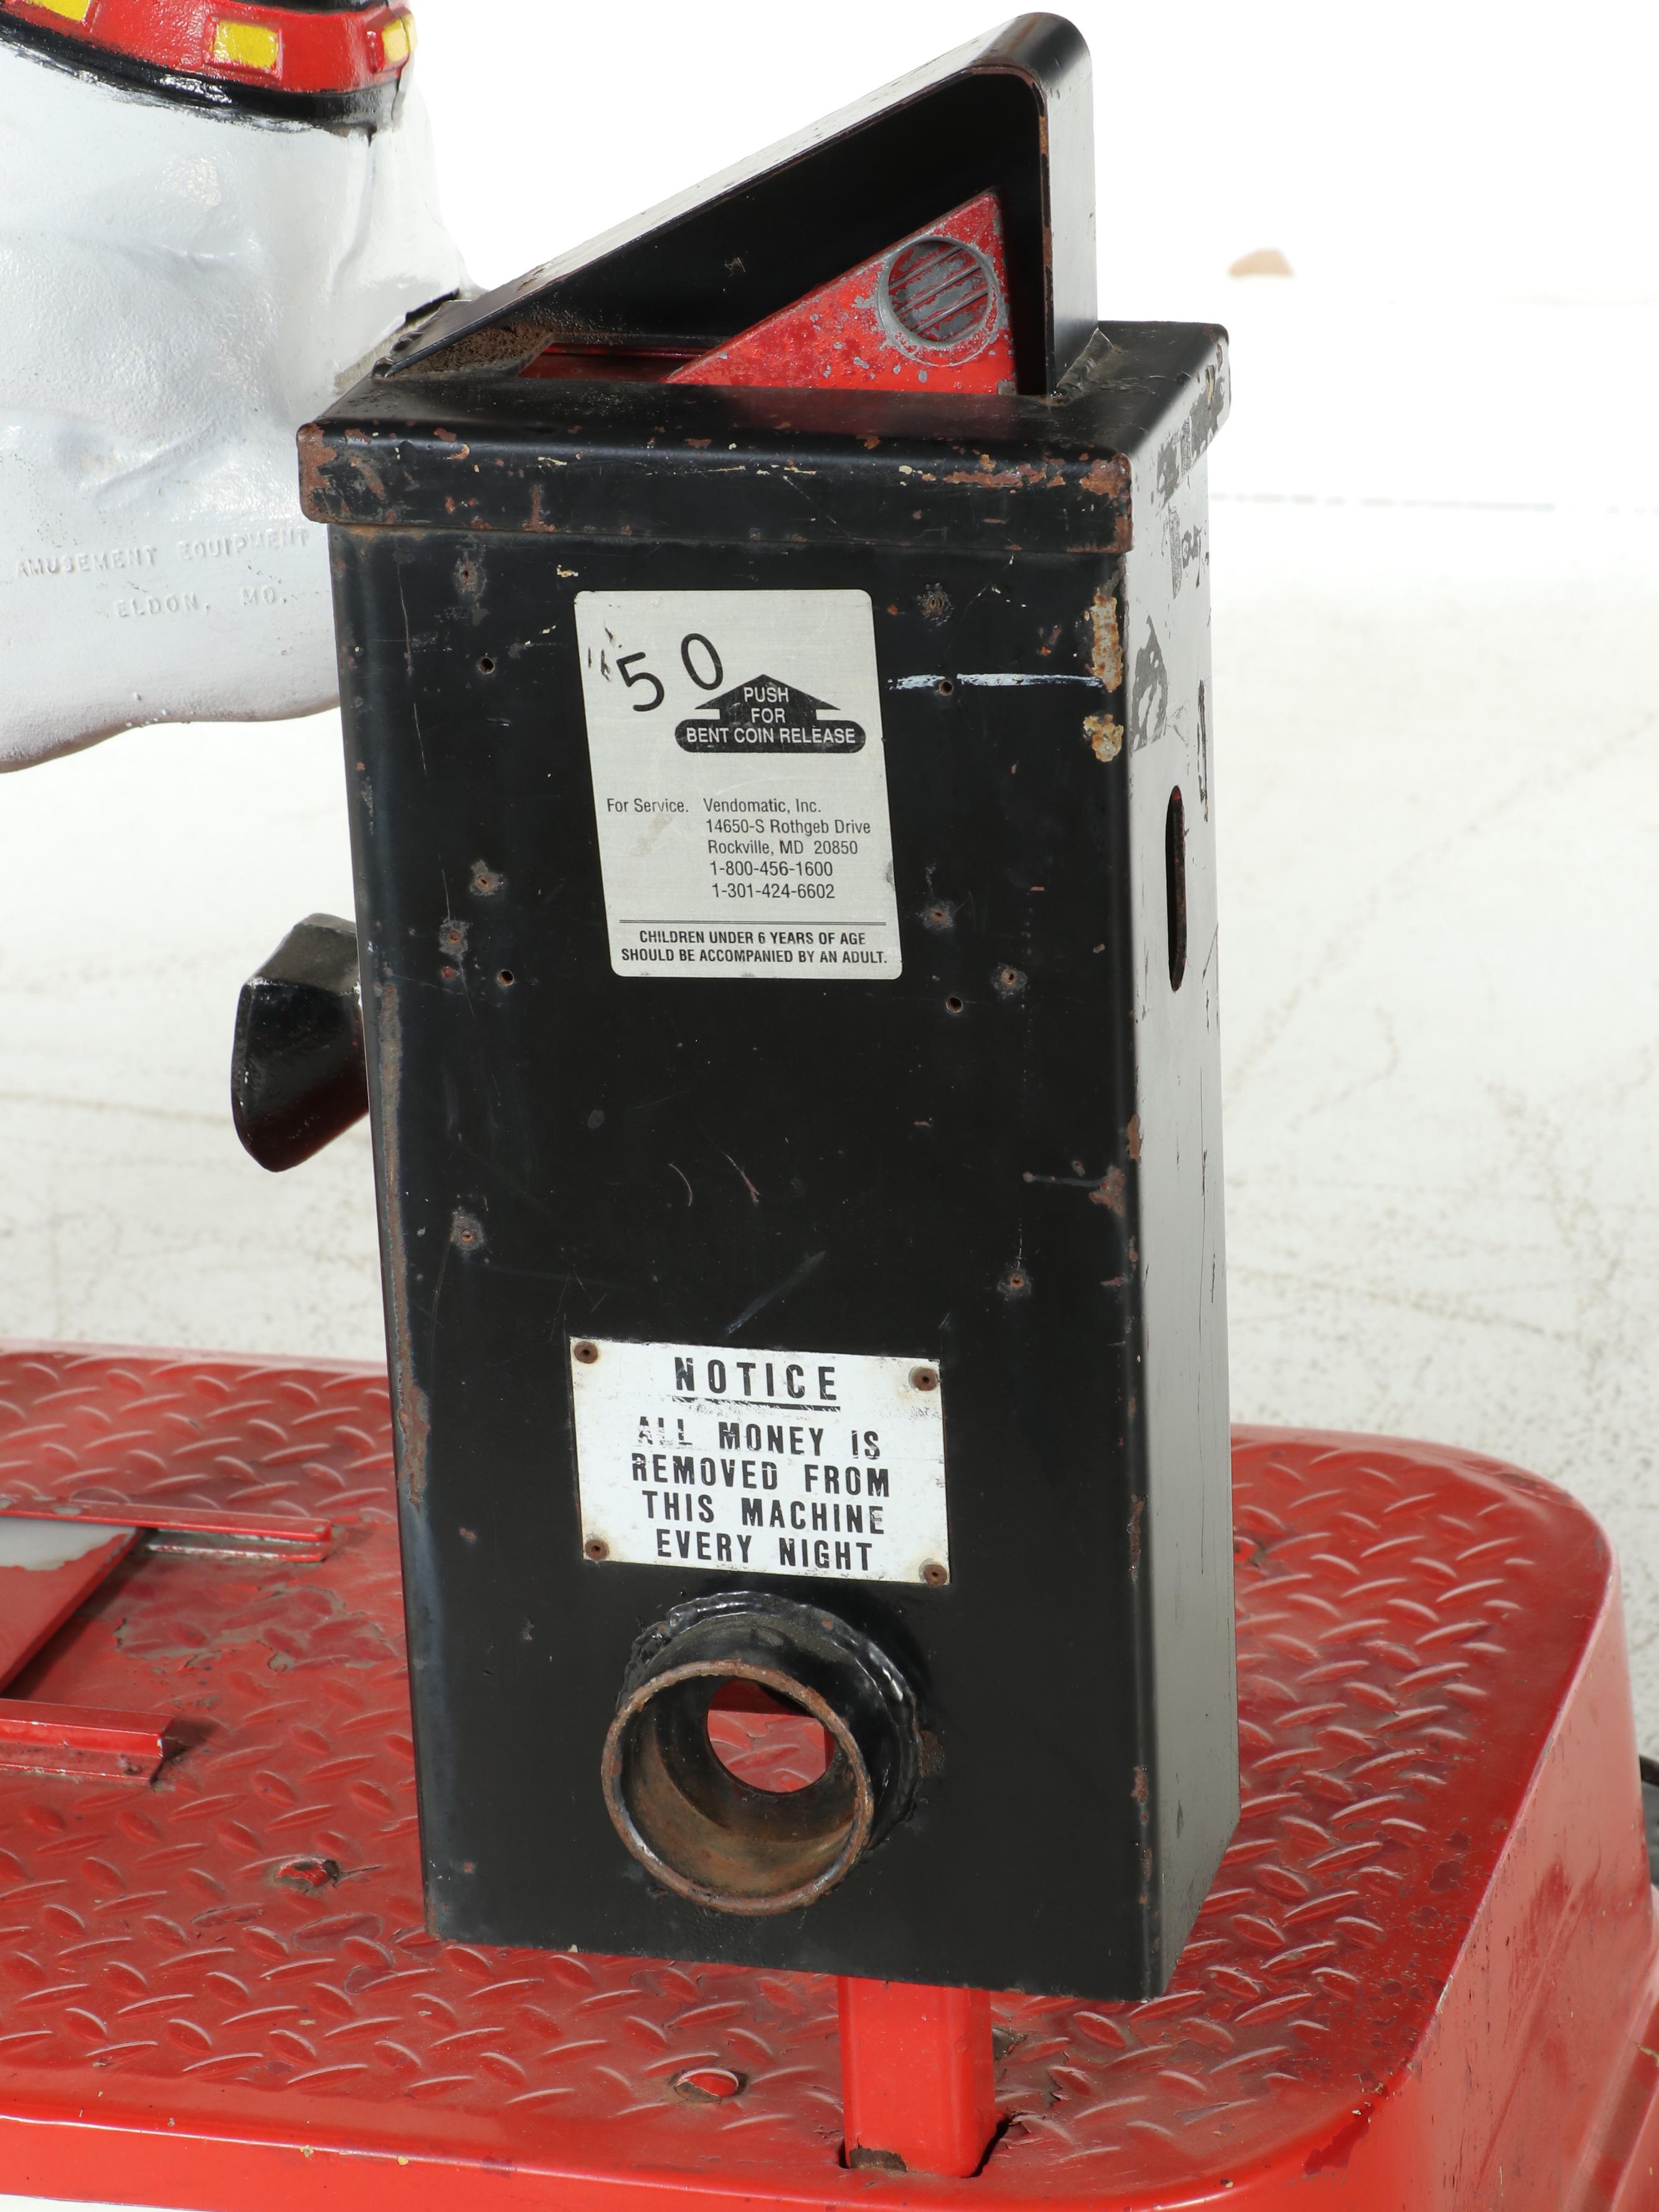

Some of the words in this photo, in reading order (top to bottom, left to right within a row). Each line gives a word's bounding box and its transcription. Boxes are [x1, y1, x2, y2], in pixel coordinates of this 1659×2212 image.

[15, 546, 157, 578] AMUSEMENT
[177, 529, 310, 561] EQUIPMENT
[116, 592, 210, 618] ELDON,
[744, 687, 788, 702] PUSH
[752, 708, 785, 723] FOR
[687, 727, 729, 742] BENT
[734, 728, 773, 743] COIN
[780, 727, 855, 743] RELEASE
[607, 798, 628, 812] For
[634, 798, 688, 812] Service.
[703, 798, 790, 814] Vendomatic,
[796, 798, 821, 812] Inc.
[706, 819, 764, 833] 14650-S
[770, 820, 829, 836] Rothgeb
[835, 820, 870, 833] Drive
[708, 840, 773, 856] Rockville,
[780, 840, 803, 854] MD
[814, 841, 858, 854] 20850
[711, 861, 833, 876] 1-800-456-1600
[712, 883, 834, 898] 1-301-424-6602
[640, 930, 704, 943] CHILDREN
[709, 932, 753, 943] UNDER
[759, 932, 765, 943] 6
[770, 932, 813, 944] YEARS
[819, 932, 834, 944] OF
[841, 933, 865, 945] AGE
[622, 948, 674, 961] SHOULD
[679, 949, 695, 961] BE
[700, 950, 793, 962] ACCOMPANIED
[798, 951, 814, 962] BY
[820, 951, 837, 963] AN
[843, 952, 887, 963] ADULT.
[674, 1356, 837, 1401] NOTICE
[638, 1416, 692, 1445] ALL
[719, 1422, 823, 1456] MONEY
[852, 1430, 880, 1460] IS
[632, 1453, 777, 1490] REMOVED
[805, 1465, 889, 1497] FROM
[642, 1490, 714, 1523] THIS
[742, 1498, 884, 1534] MACHINE
[657, 1529, 752, 1563] EVERY
[779, 1538, 872, 1571] NIGHT
